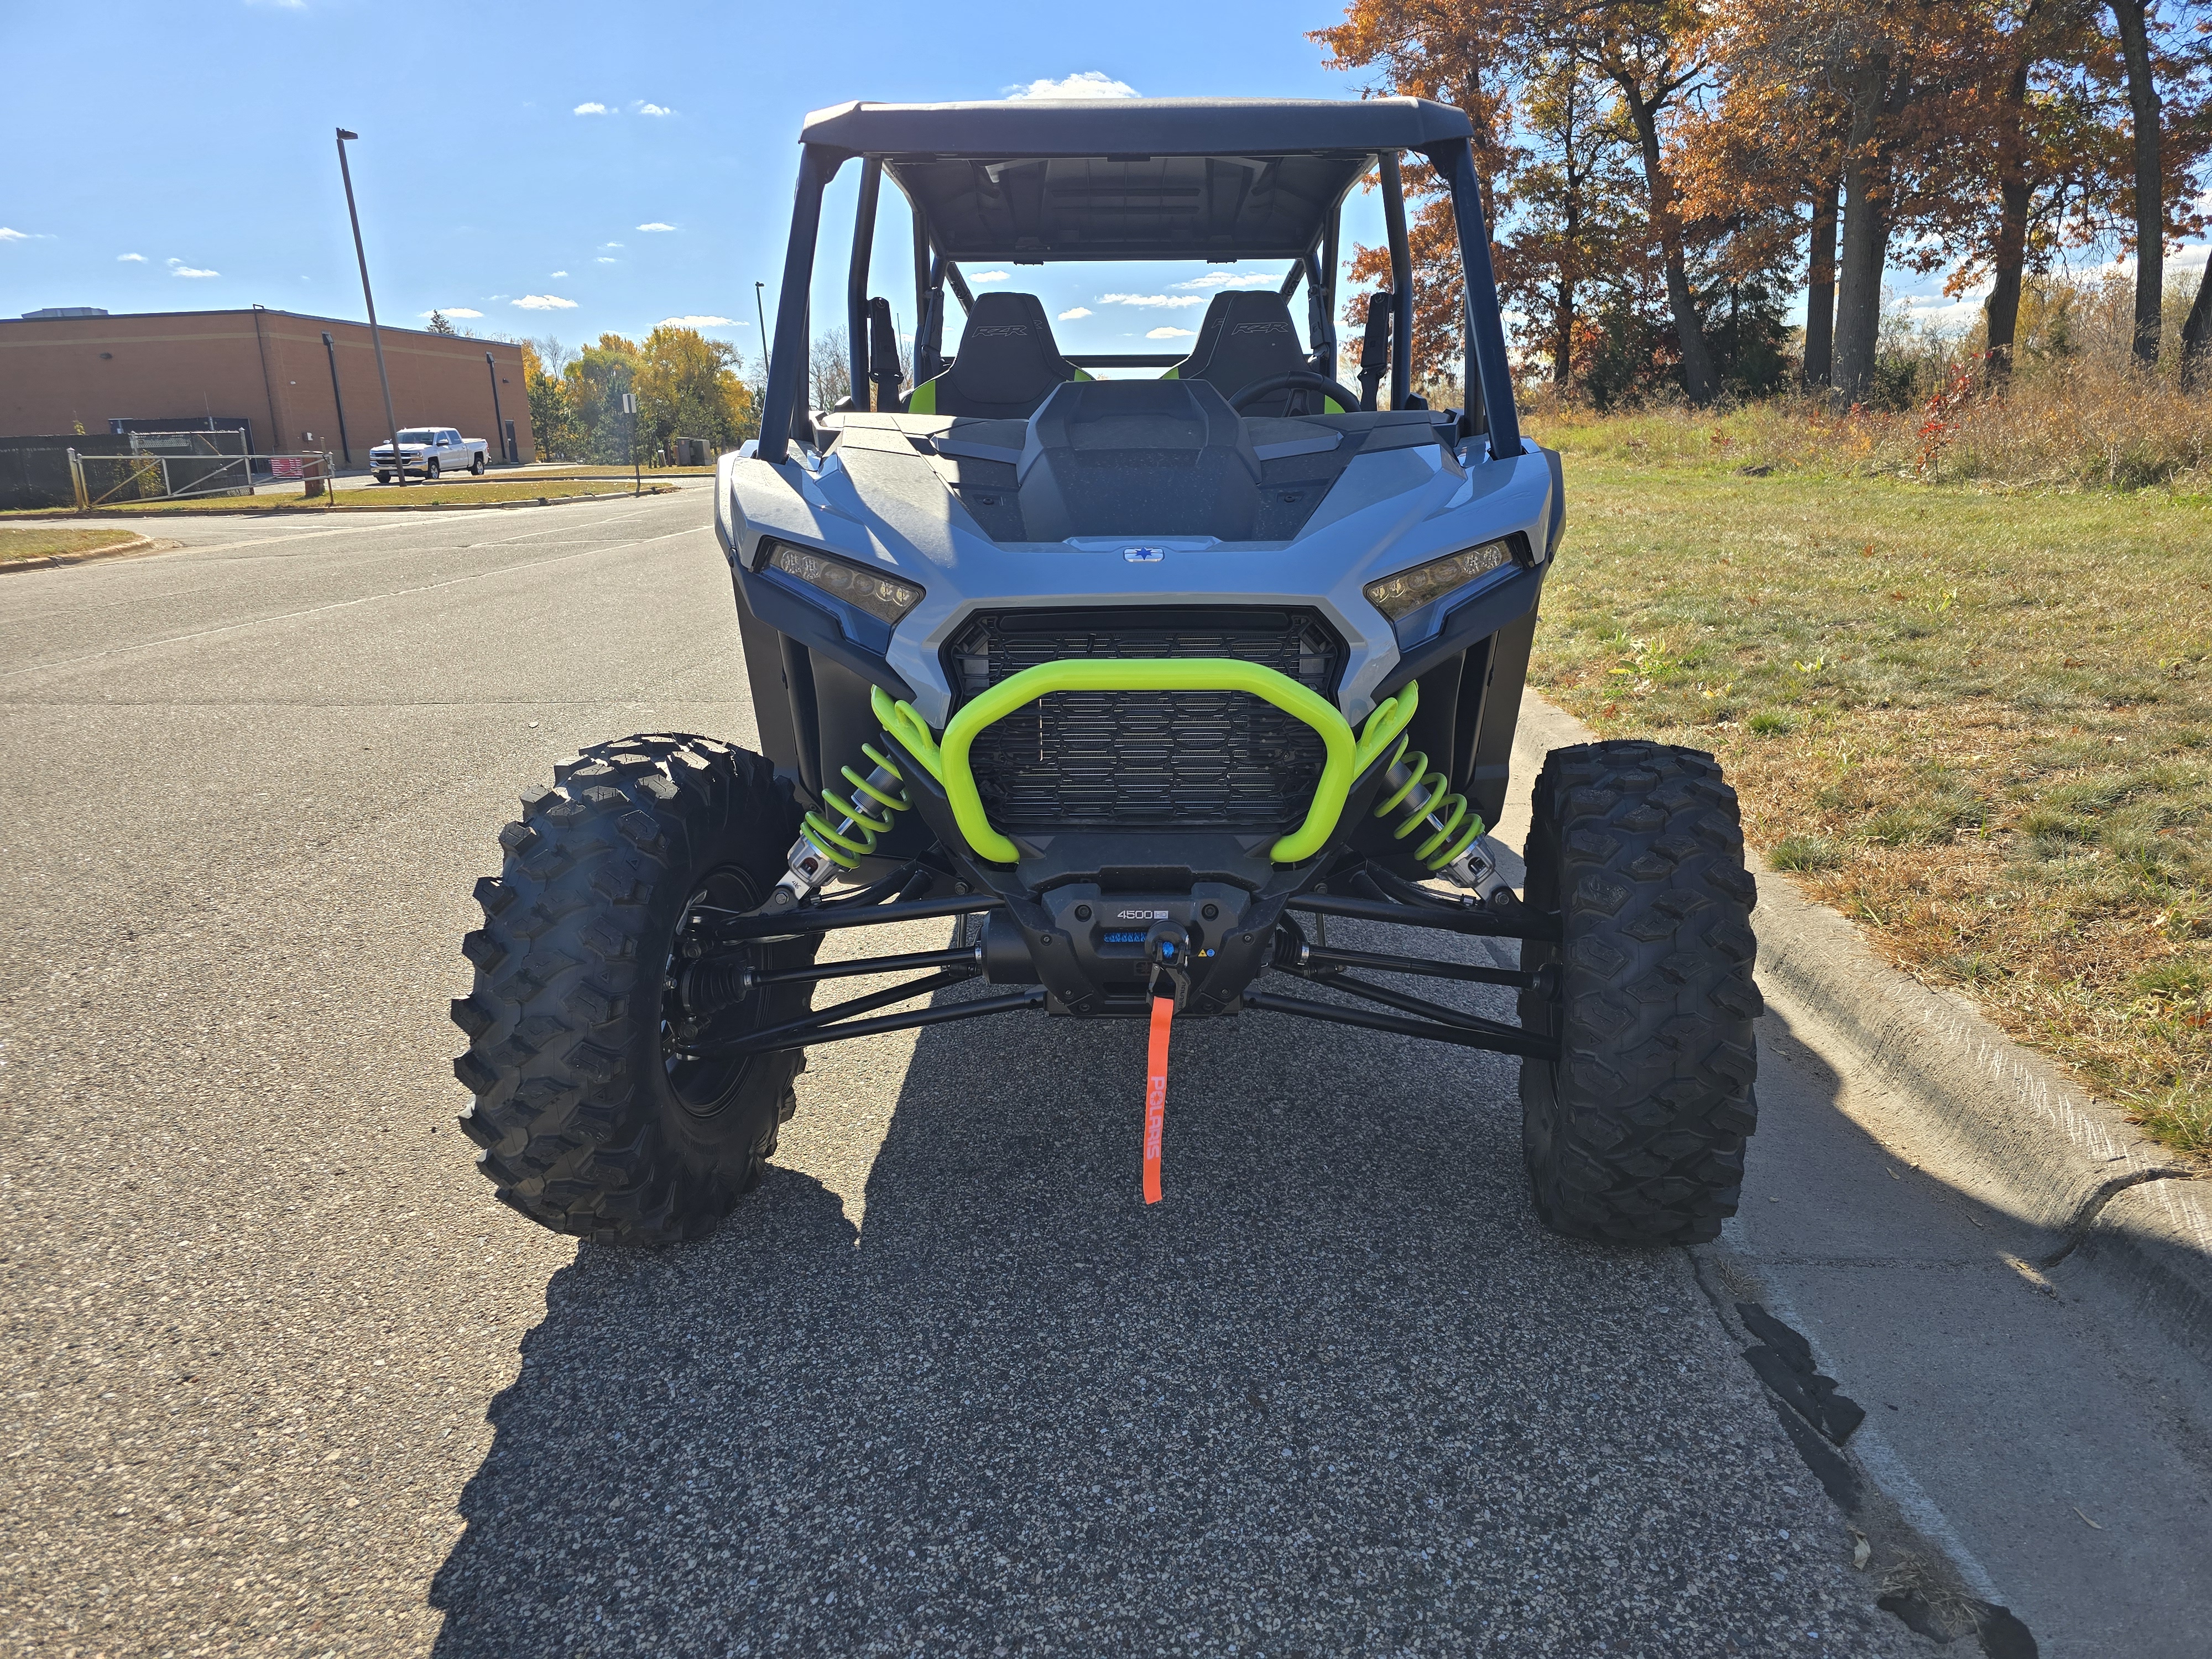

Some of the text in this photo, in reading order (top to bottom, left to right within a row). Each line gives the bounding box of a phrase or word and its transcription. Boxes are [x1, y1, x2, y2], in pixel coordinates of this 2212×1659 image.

[972, 325, 1027, 338] RZR
[1231, 321, 1288, 335] RZR
[1117, 910, 1153, 919] 4500
[1146, 1076, 1165, 1160] POLARIS
